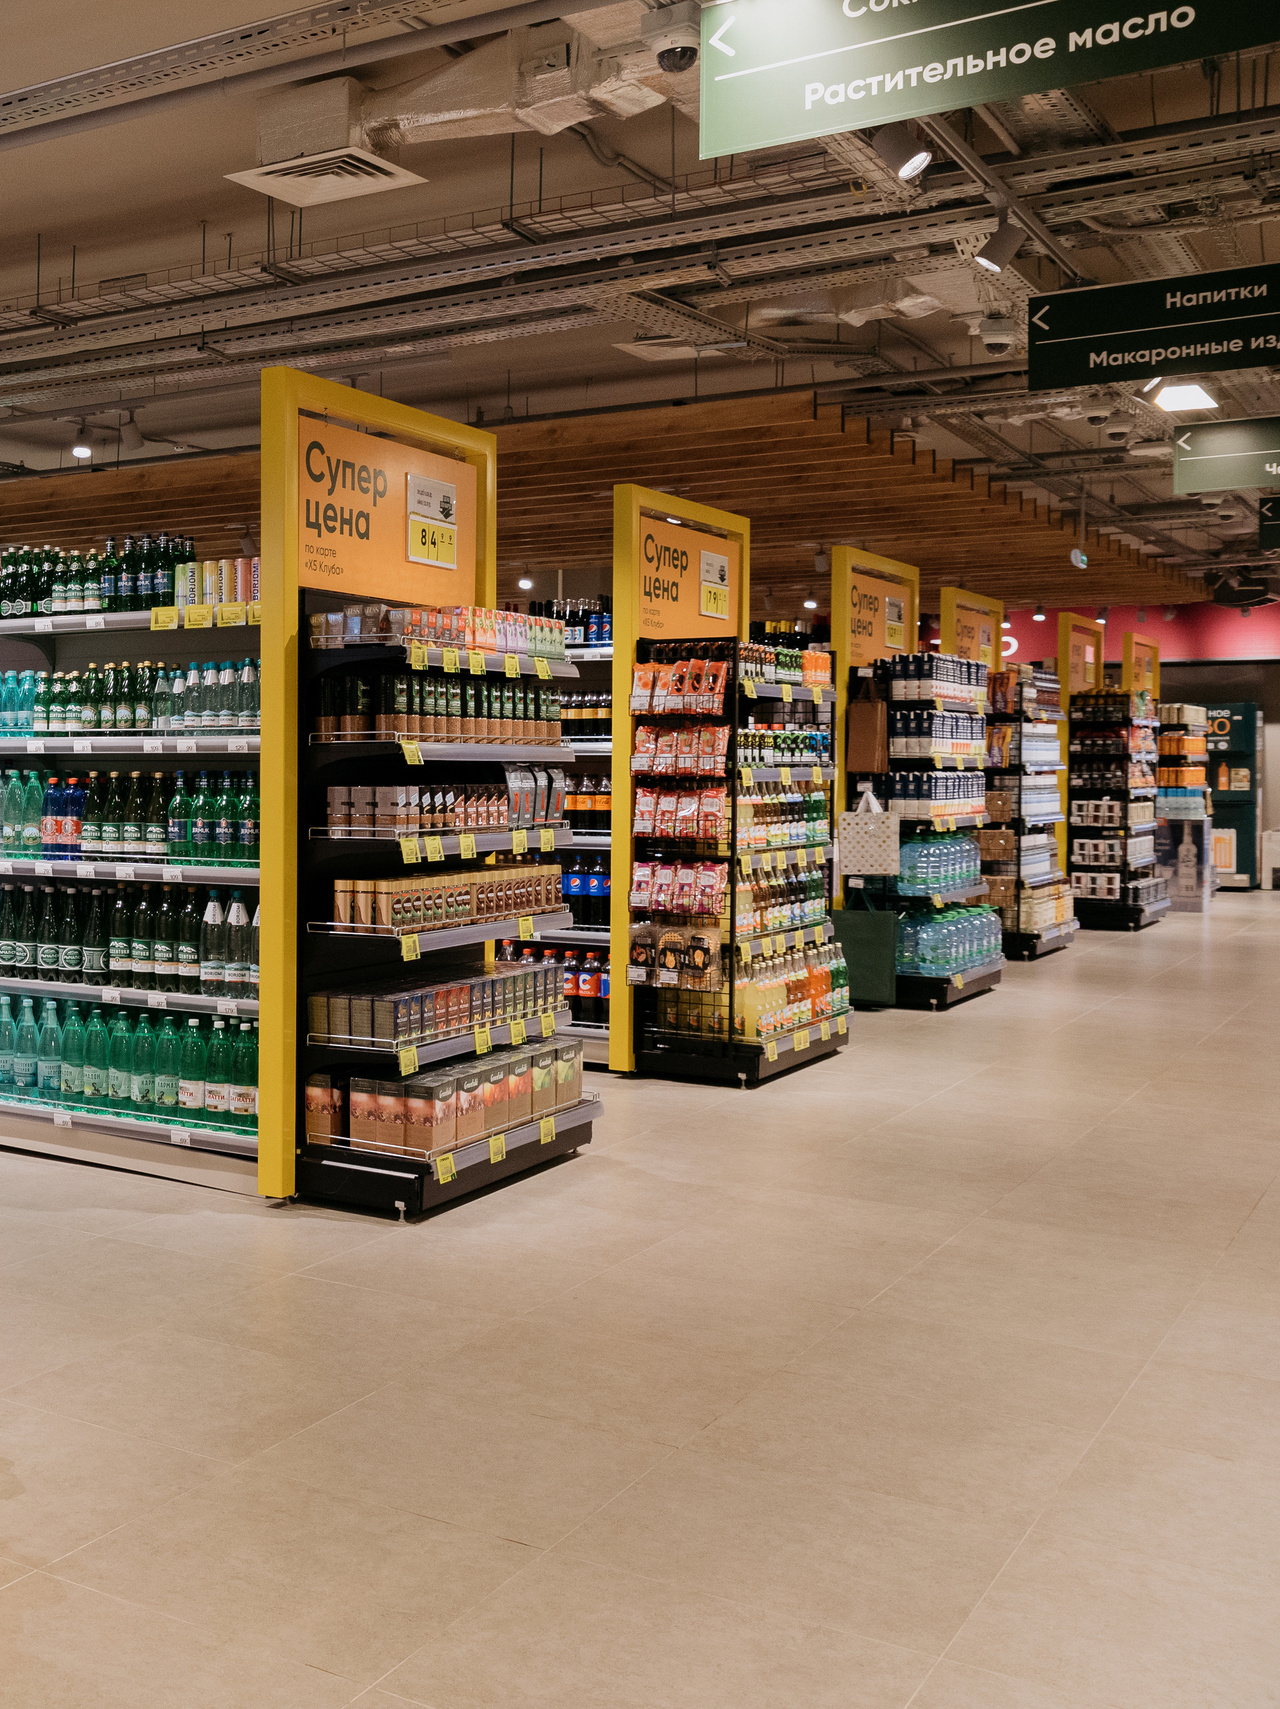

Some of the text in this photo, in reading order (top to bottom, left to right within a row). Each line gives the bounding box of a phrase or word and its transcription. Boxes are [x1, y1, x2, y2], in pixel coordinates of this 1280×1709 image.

[805, 5, 1196, 110] Растительное масло
[1166, 283, 1268, 309] Напитки
[1089, 338, 1243, 368] Макаронные
[305, 440, 388, 507] Супер
[305, 499, 370, 541] цена
[304, 544, 337, 559] по карте
[420, 528, 437, 548] 84
[319, 561, 344, 576] Клуба»
[644, 533, 689, 578] Супер
[188, 567, 196, 605] BORJOMI
[643, 575, 679, 603] цена
[851, 585, 879, 618] Супер
[850, 617, 873, 638] цена
